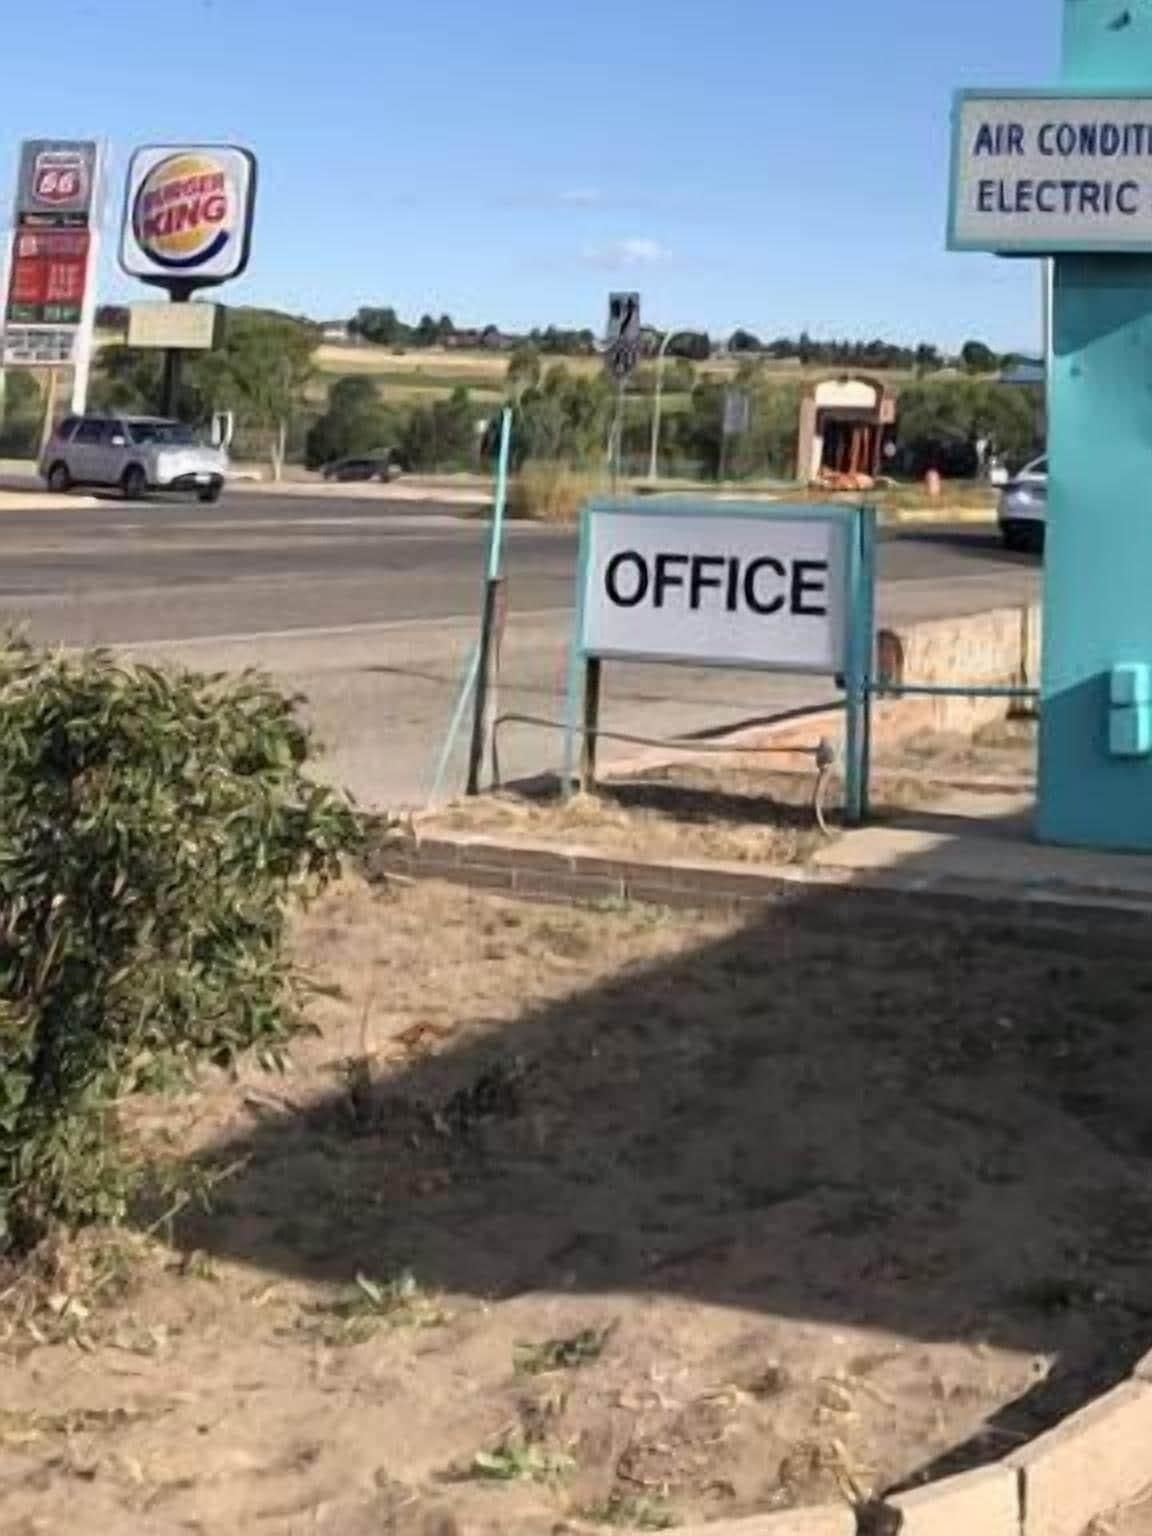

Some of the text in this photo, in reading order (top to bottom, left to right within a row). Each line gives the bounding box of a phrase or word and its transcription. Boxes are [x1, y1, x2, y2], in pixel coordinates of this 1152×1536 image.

[973, 122, 1024, 156] AIR
[39, 172, 74, 193] 66
[976, 179, 1139, 214] ELECTRIC
[143, 195, 227, 240] KING
[604, 549, 829, 615] OFFICE
